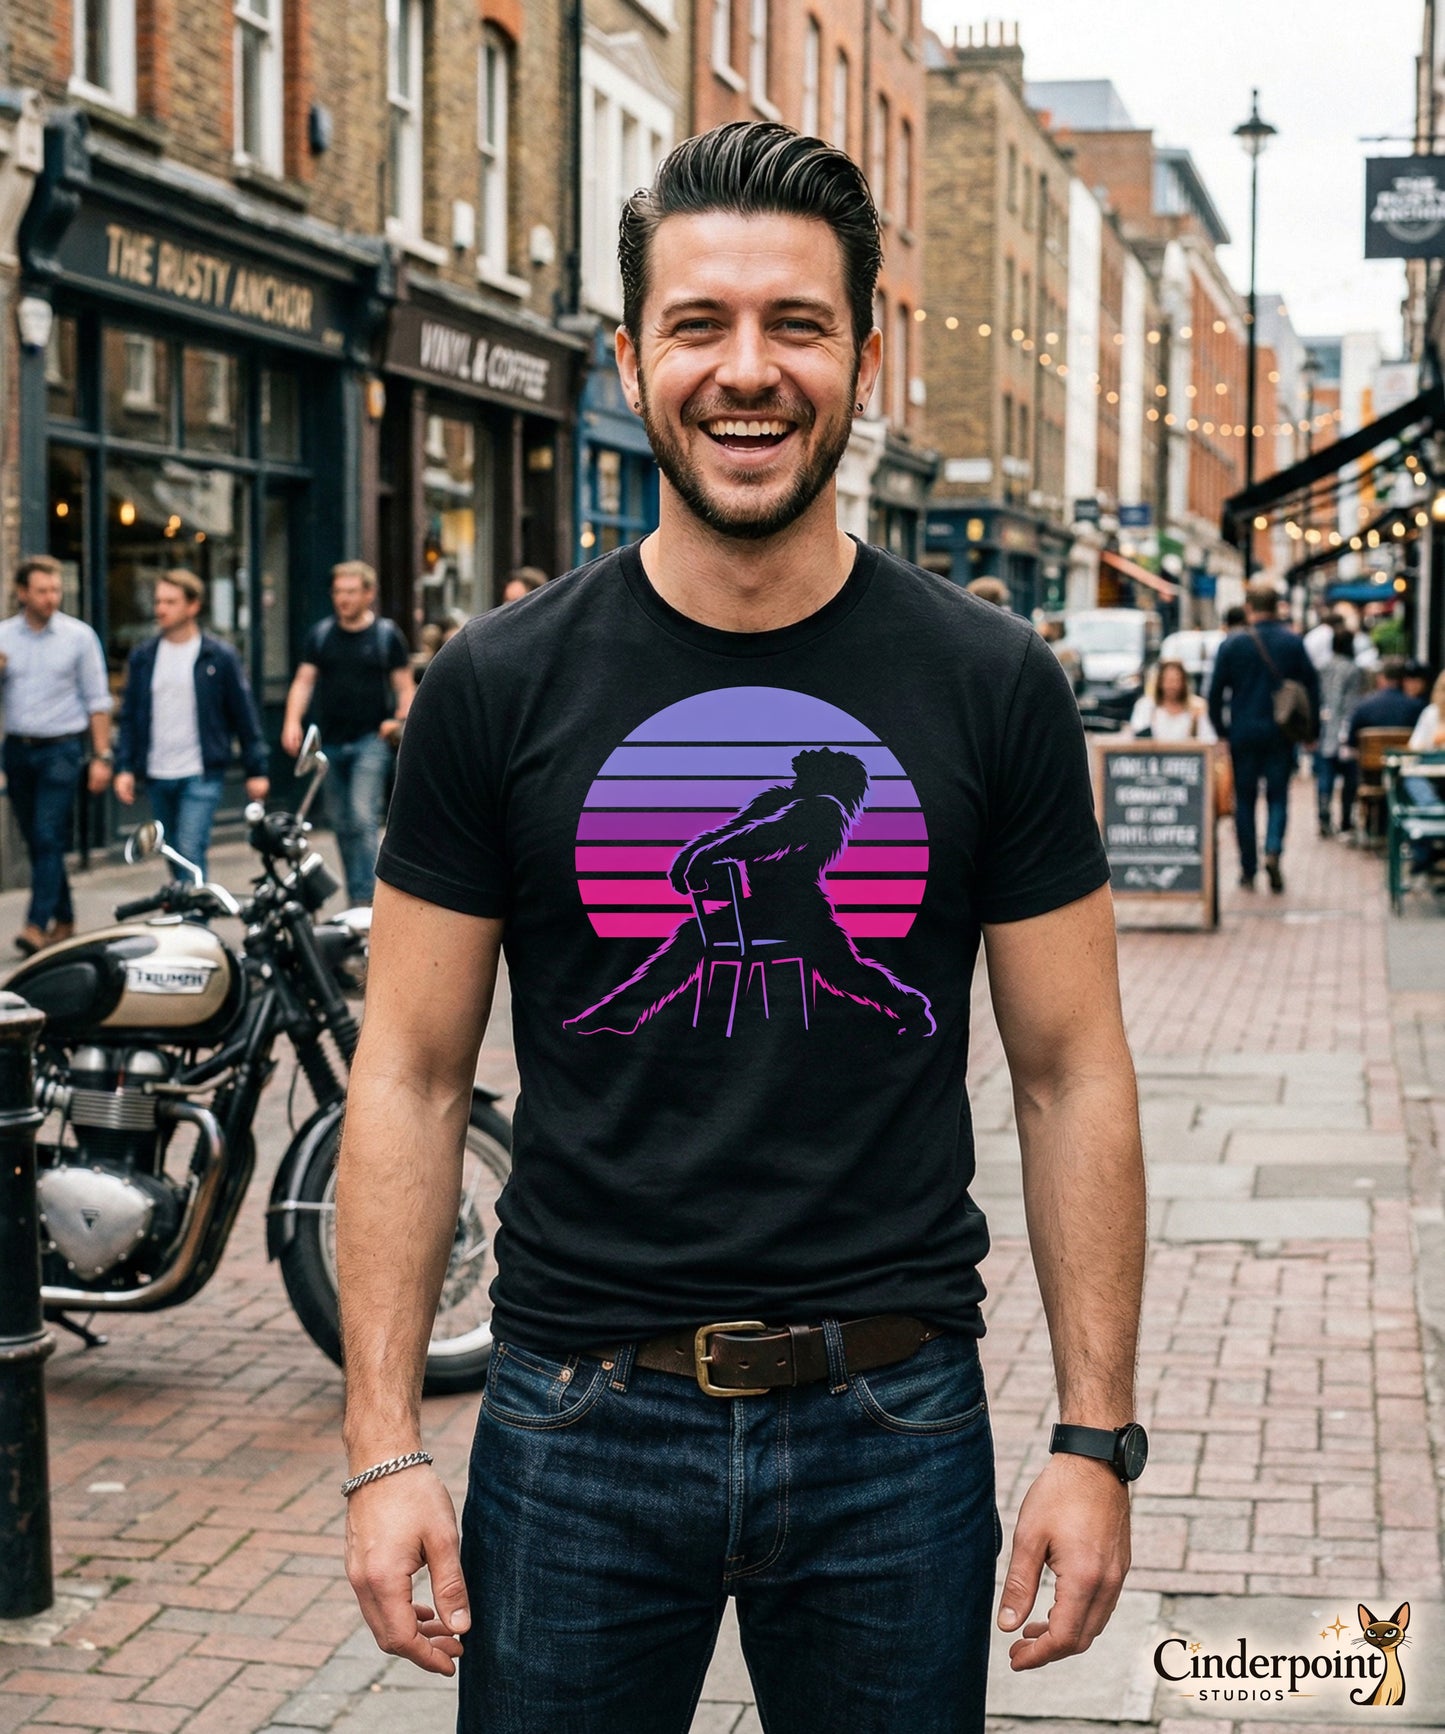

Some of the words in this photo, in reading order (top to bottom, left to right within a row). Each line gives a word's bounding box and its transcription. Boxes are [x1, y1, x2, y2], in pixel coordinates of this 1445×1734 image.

[106, 223, 155, 287] THE
[156, 240, 231, 307] RUSTY
[229, 266, 314, 332] ANCHOR
[420, 320, 472, 380] VINYL
[471, 338, 489, 384] &
[487, 344, 549, 402] COFFEE
[136, 969, 204, 985] TRIUMPH
